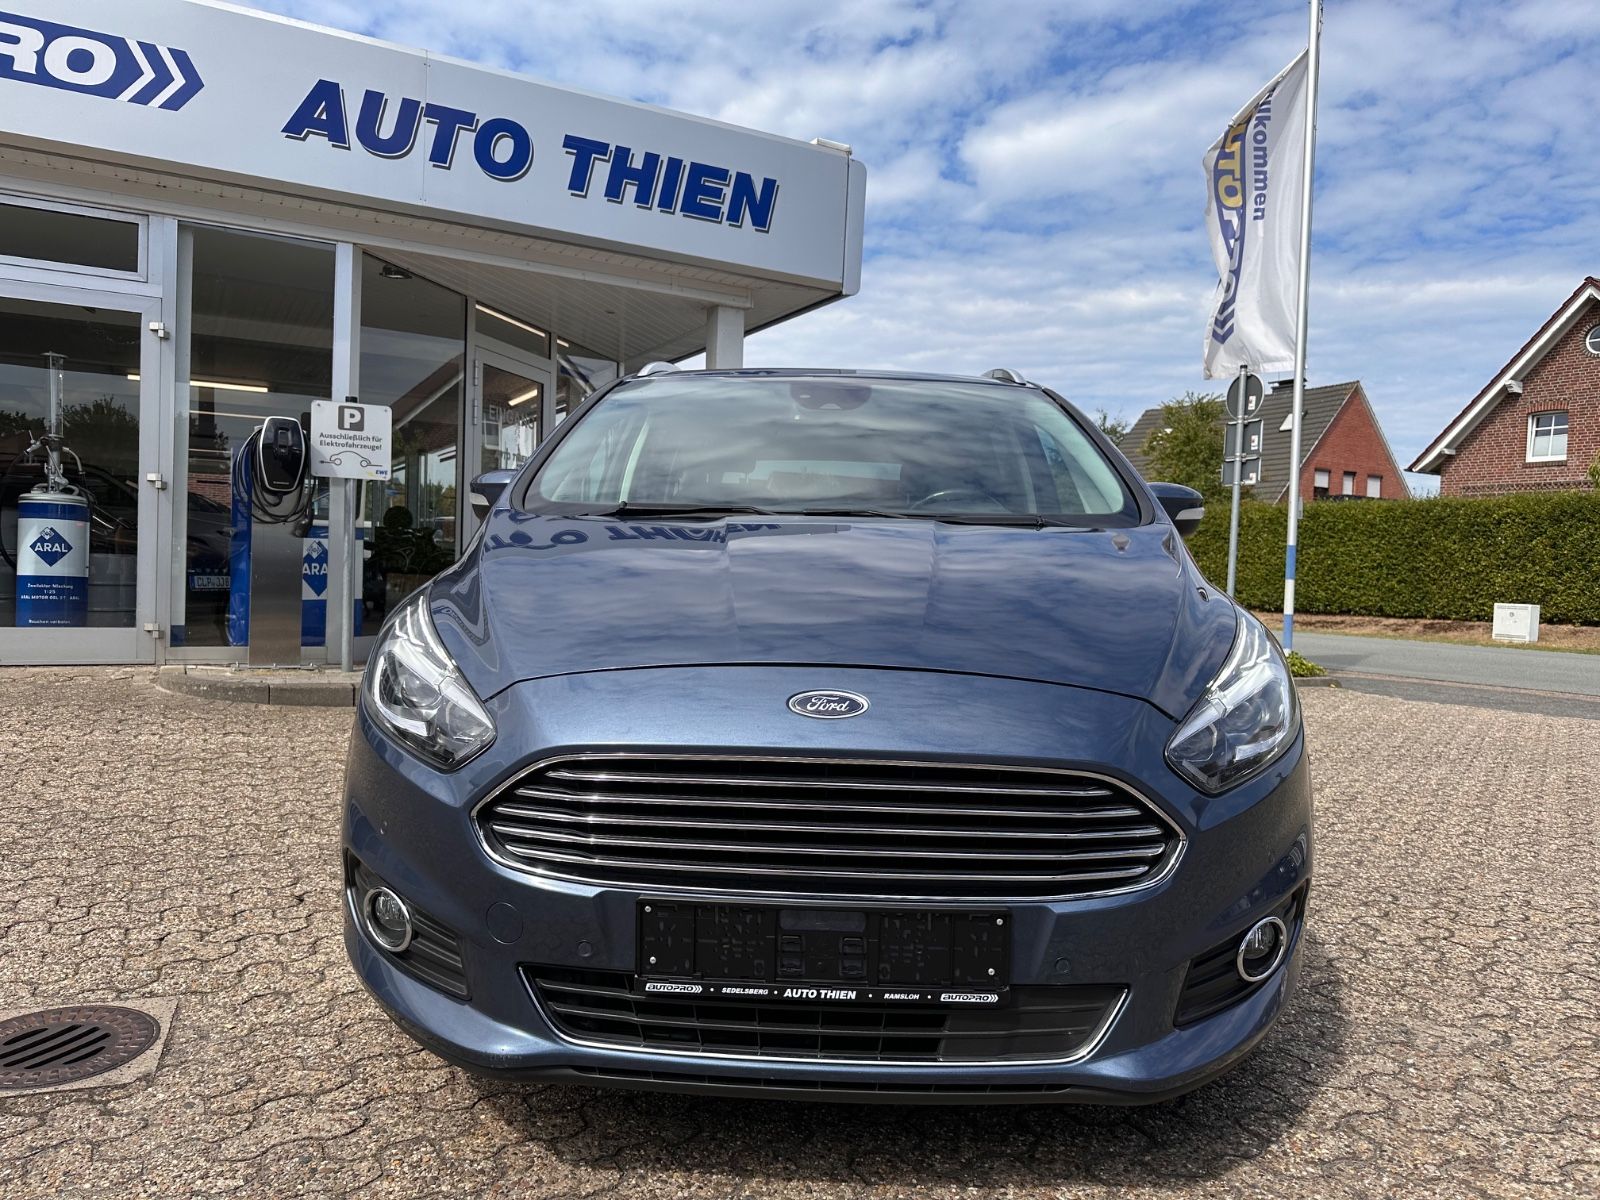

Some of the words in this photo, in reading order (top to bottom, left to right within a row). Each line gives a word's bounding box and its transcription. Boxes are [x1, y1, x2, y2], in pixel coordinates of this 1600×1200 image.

[281, 79, 534, 182] AUTO
[562, 134, 779, 234] THIEN
[343, 408, 362, 429] P
[319, 432, 371, 443] Ausschließlich
[319, 440, 382, 452] Elektrofahrzeuge!
[34, 542, 68, 553] ARAL
[303, 563, 328, 576] ARA
[806, 695, 850, 711] Ford
[721, 987, 769, 995] SEDELSBERG
[784, 988, 817, 999] AUTO
[819, 989, 857, 1000] THIEN
[884, 993, 920, 1001] RAMSLOH
